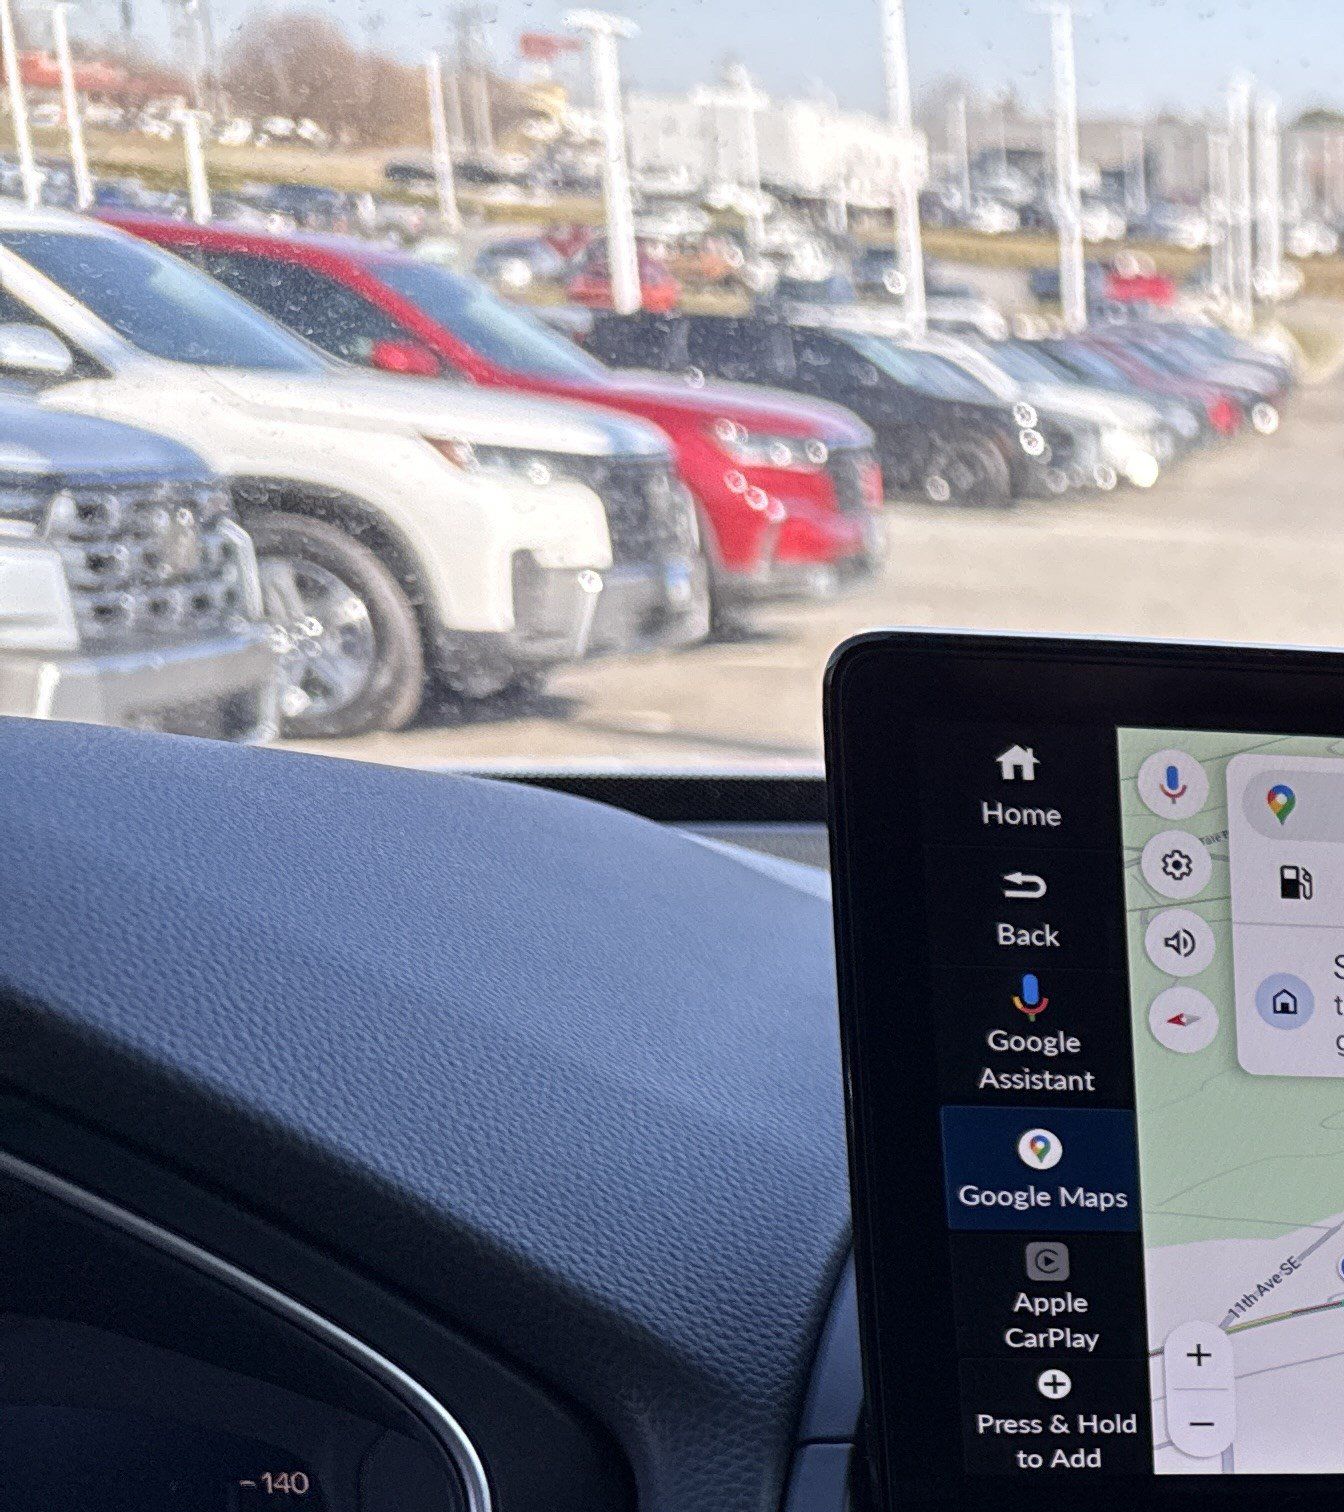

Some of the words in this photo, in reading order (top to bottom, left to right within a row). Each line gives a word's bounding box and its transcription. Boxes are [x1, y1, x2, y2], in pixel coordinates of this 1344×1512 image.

[981, 802, 1062, 827] Home
[998, 922, 1061, 948] Back
[987, 1029, 1082, 1058] Google
[979, 1067, 1096, 1092] Assistant
[958, 1185, 1052, 1211] Google
[1059, 1186, 1128, 1211] Maps
[1228, 1294, 1259, 1319] 11th
[1256, 1273, 1283, 1297] Ave
[1279, 1255, 1302, 1276] SE
[1013, 1292, 1089, 1318] Apple
[1004, 1326, 1101, 1354] CarPlay
[976, 1414, 1043, 1437] Press
[1049, 1414, 1071, 1437] &
[1078, 1413, 1138, 1437] Hold
[1016, 1449, 1044, 1469] to
[1050, 1448, 1102, 1469] Add
[261, 1471, 310, 1495] 140
